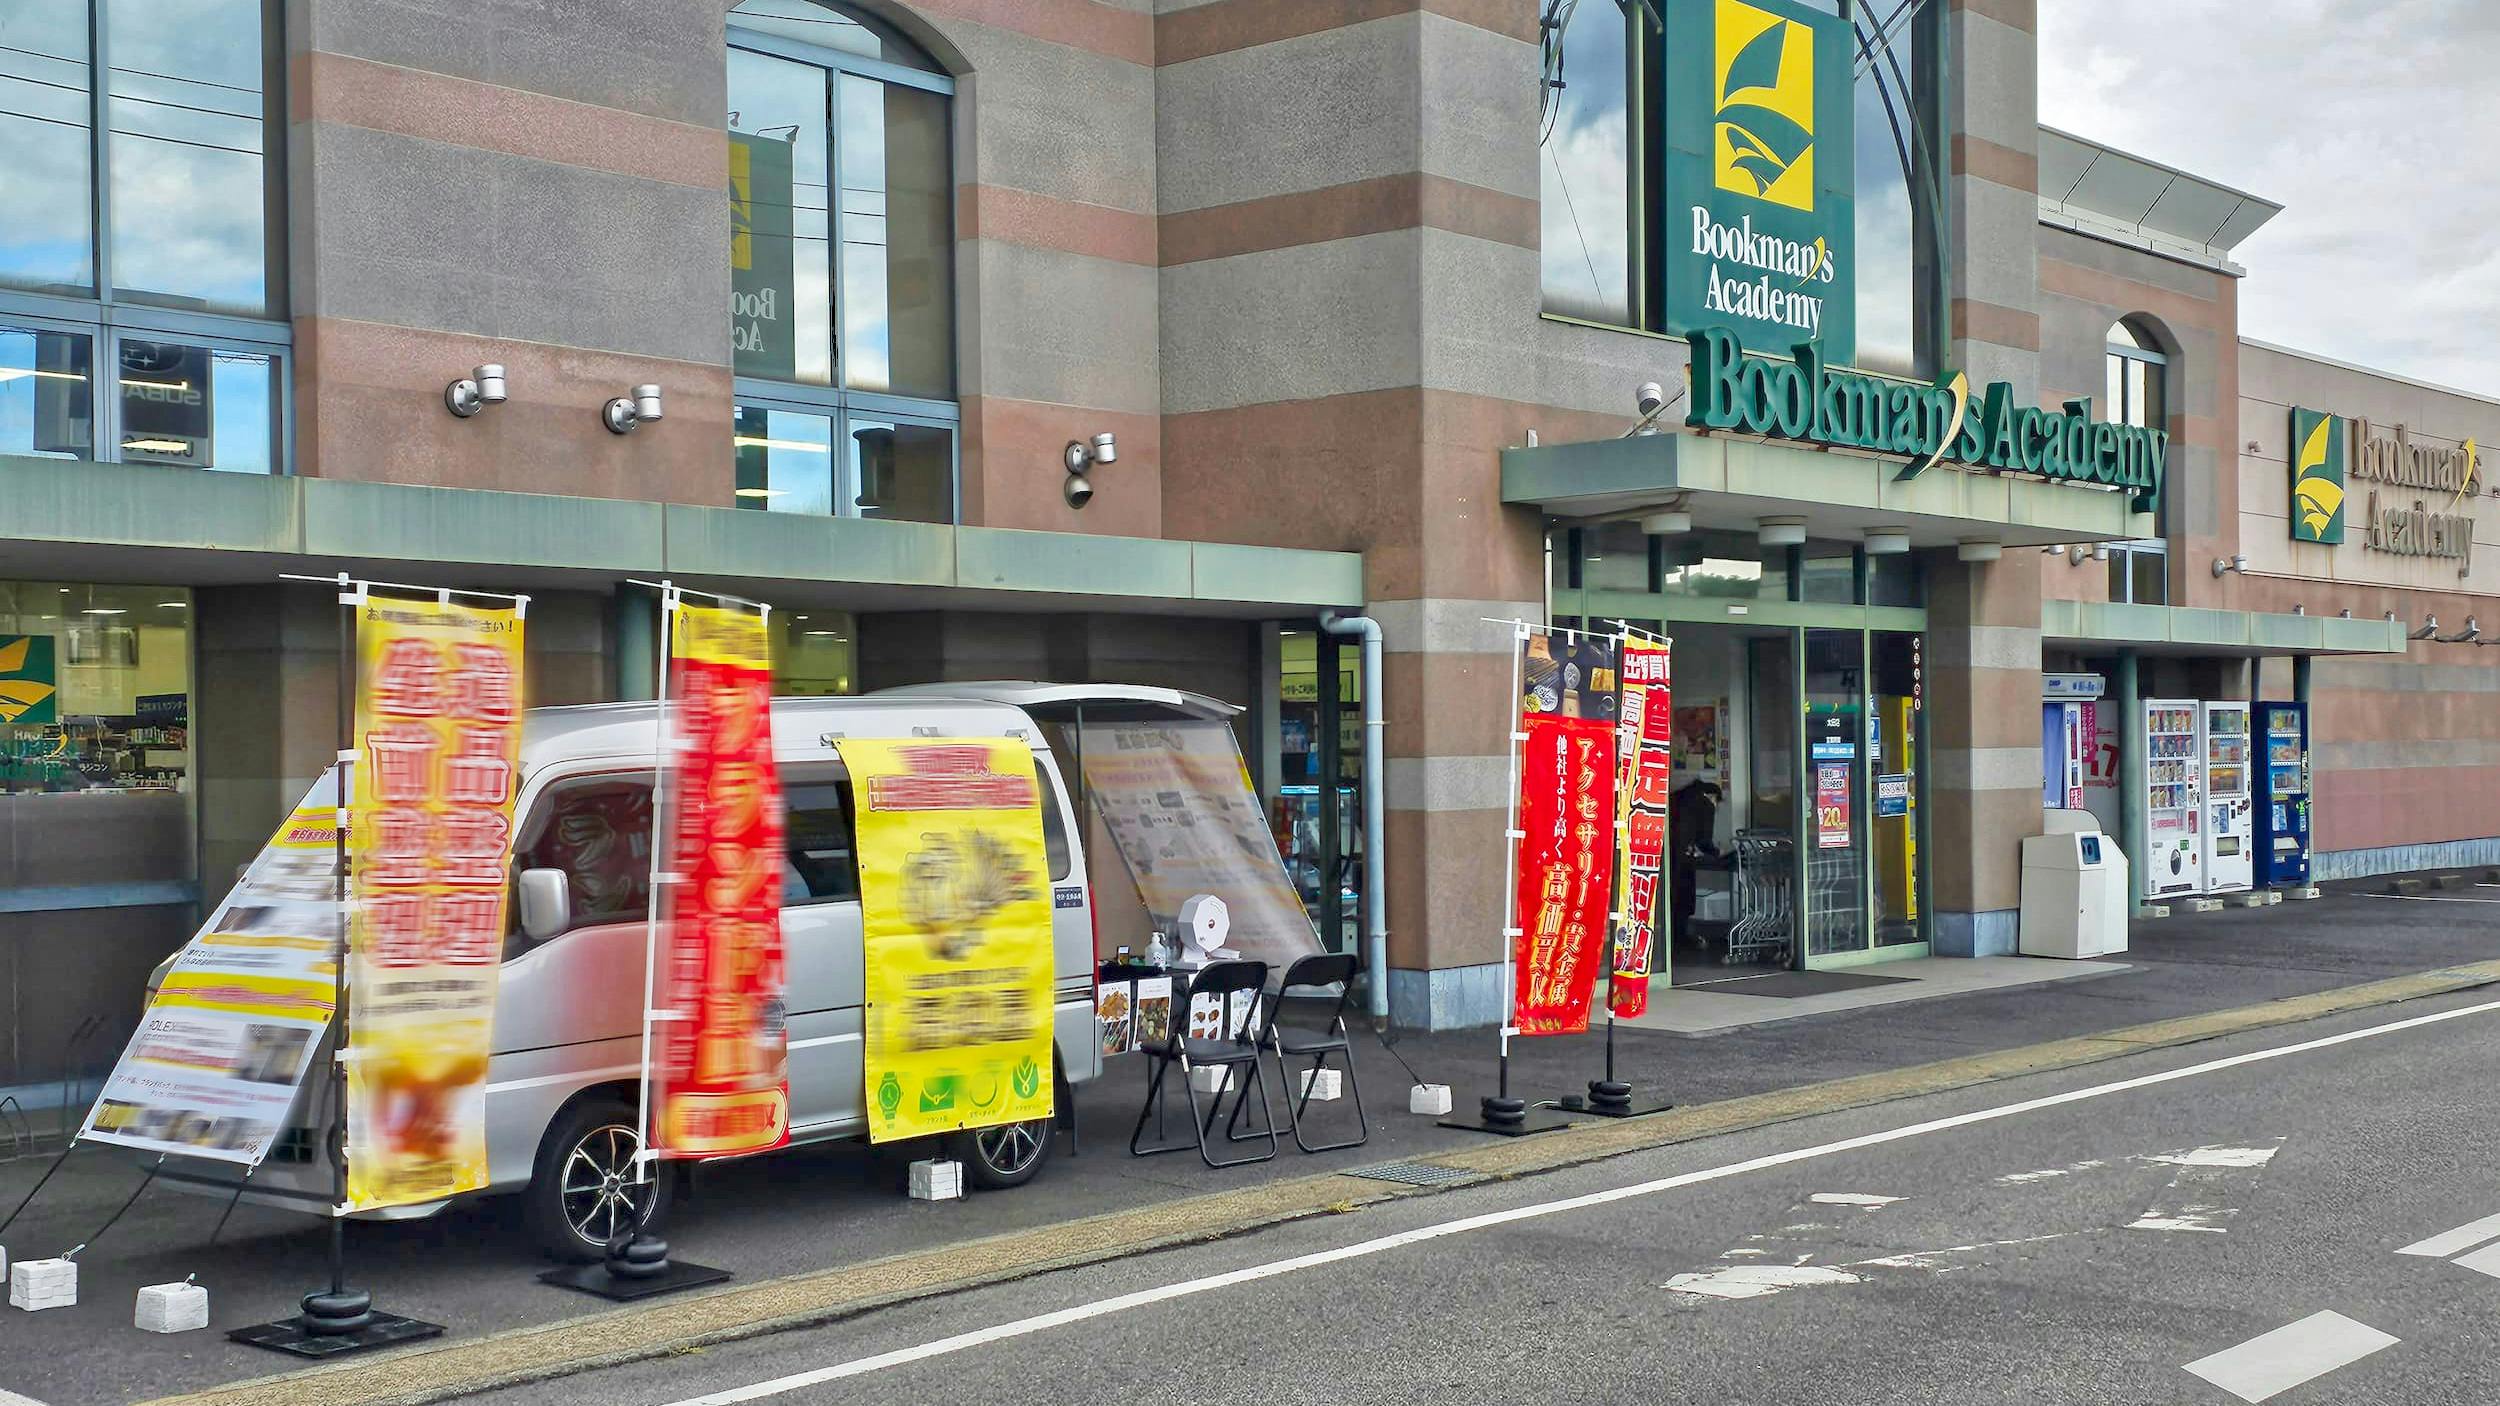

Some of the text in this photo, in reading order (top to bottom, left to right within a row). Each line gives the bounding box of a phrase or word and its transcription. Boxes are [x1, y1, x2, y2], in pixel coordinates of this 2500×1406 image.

[1692, 206, 1834, 286] Bookman's
[1704, 263, 1823, 339] Academy
[1685, 326, 2169, 513] Bookman's Academy
[2352, 416, 2483, 507] Bookman's
[2364, 488, 2476, 577] Academy
[1553, 735, 1568, 859] 他社より高く
